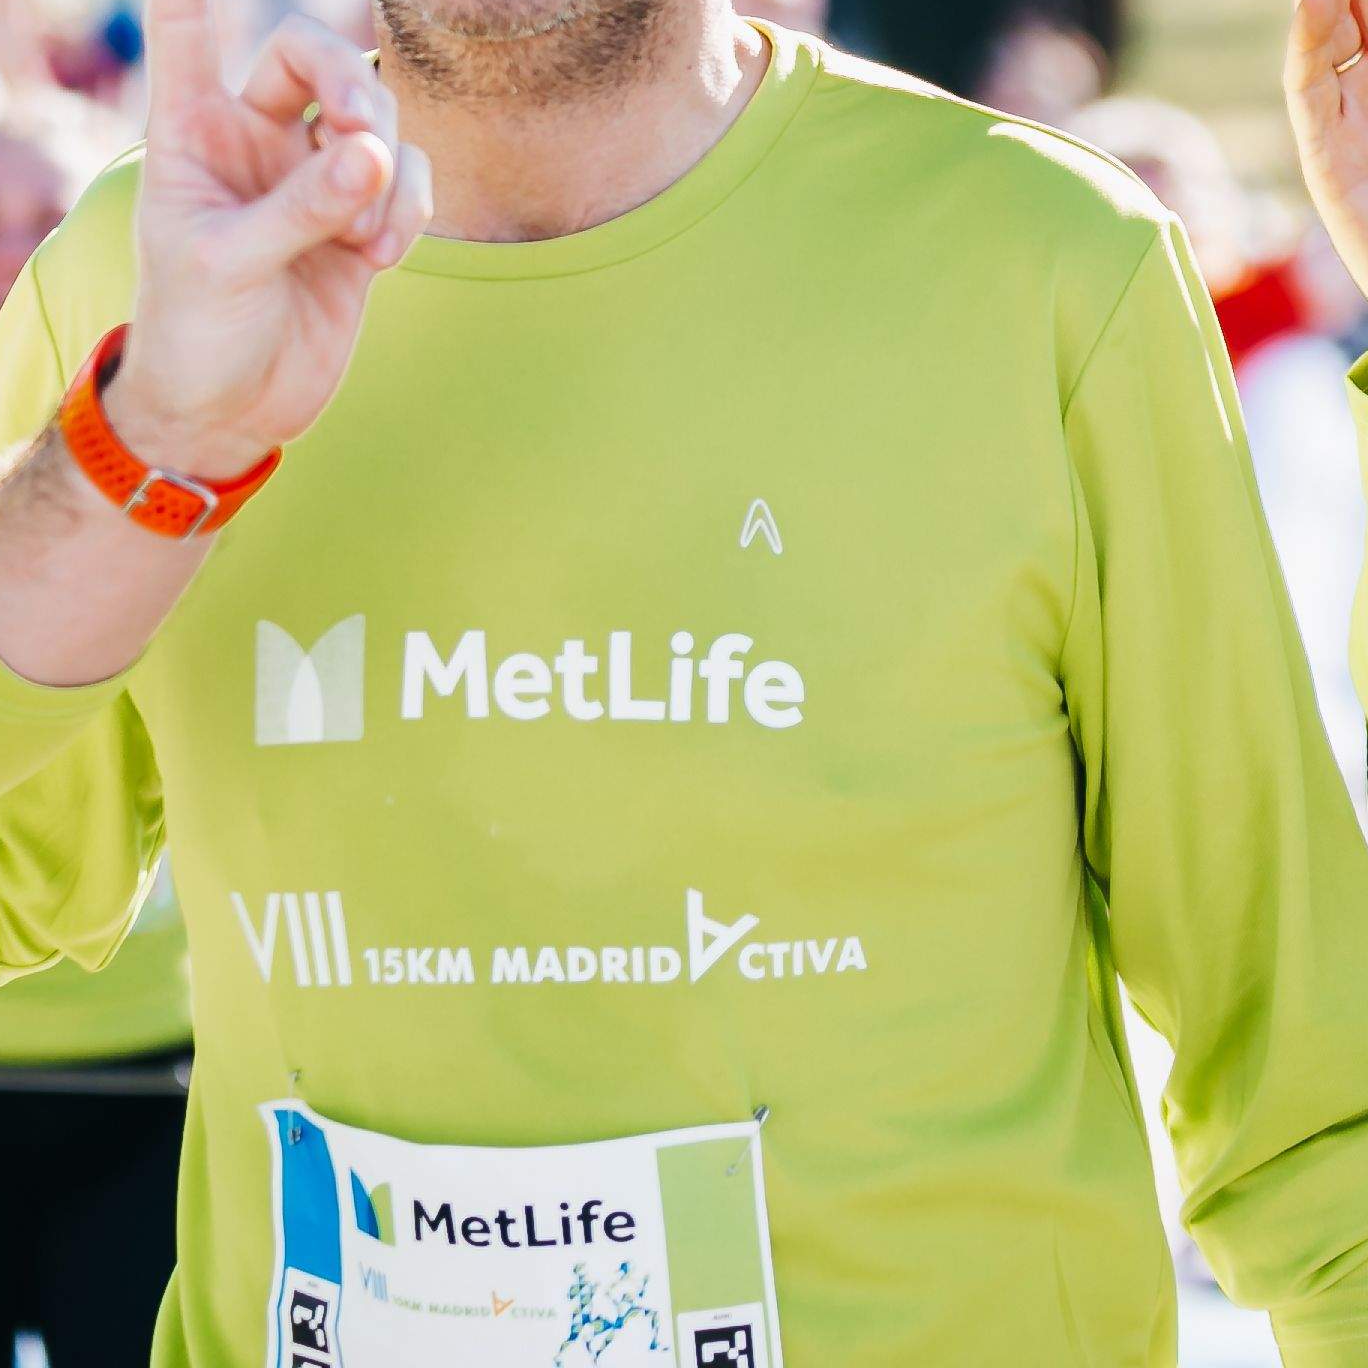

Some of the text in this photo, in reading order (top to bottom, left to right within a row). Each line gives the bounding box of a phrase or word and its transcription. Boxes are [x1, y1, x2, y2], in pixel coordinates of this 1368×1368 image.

[401, 630, 806, 728] MetLife
[232, 890, 351, 987] VIII
[363, 946, 475, 984] 15KM
[491, 946, 682, 984] MADRID
[412, 1199, 637, 1248] MetLife
